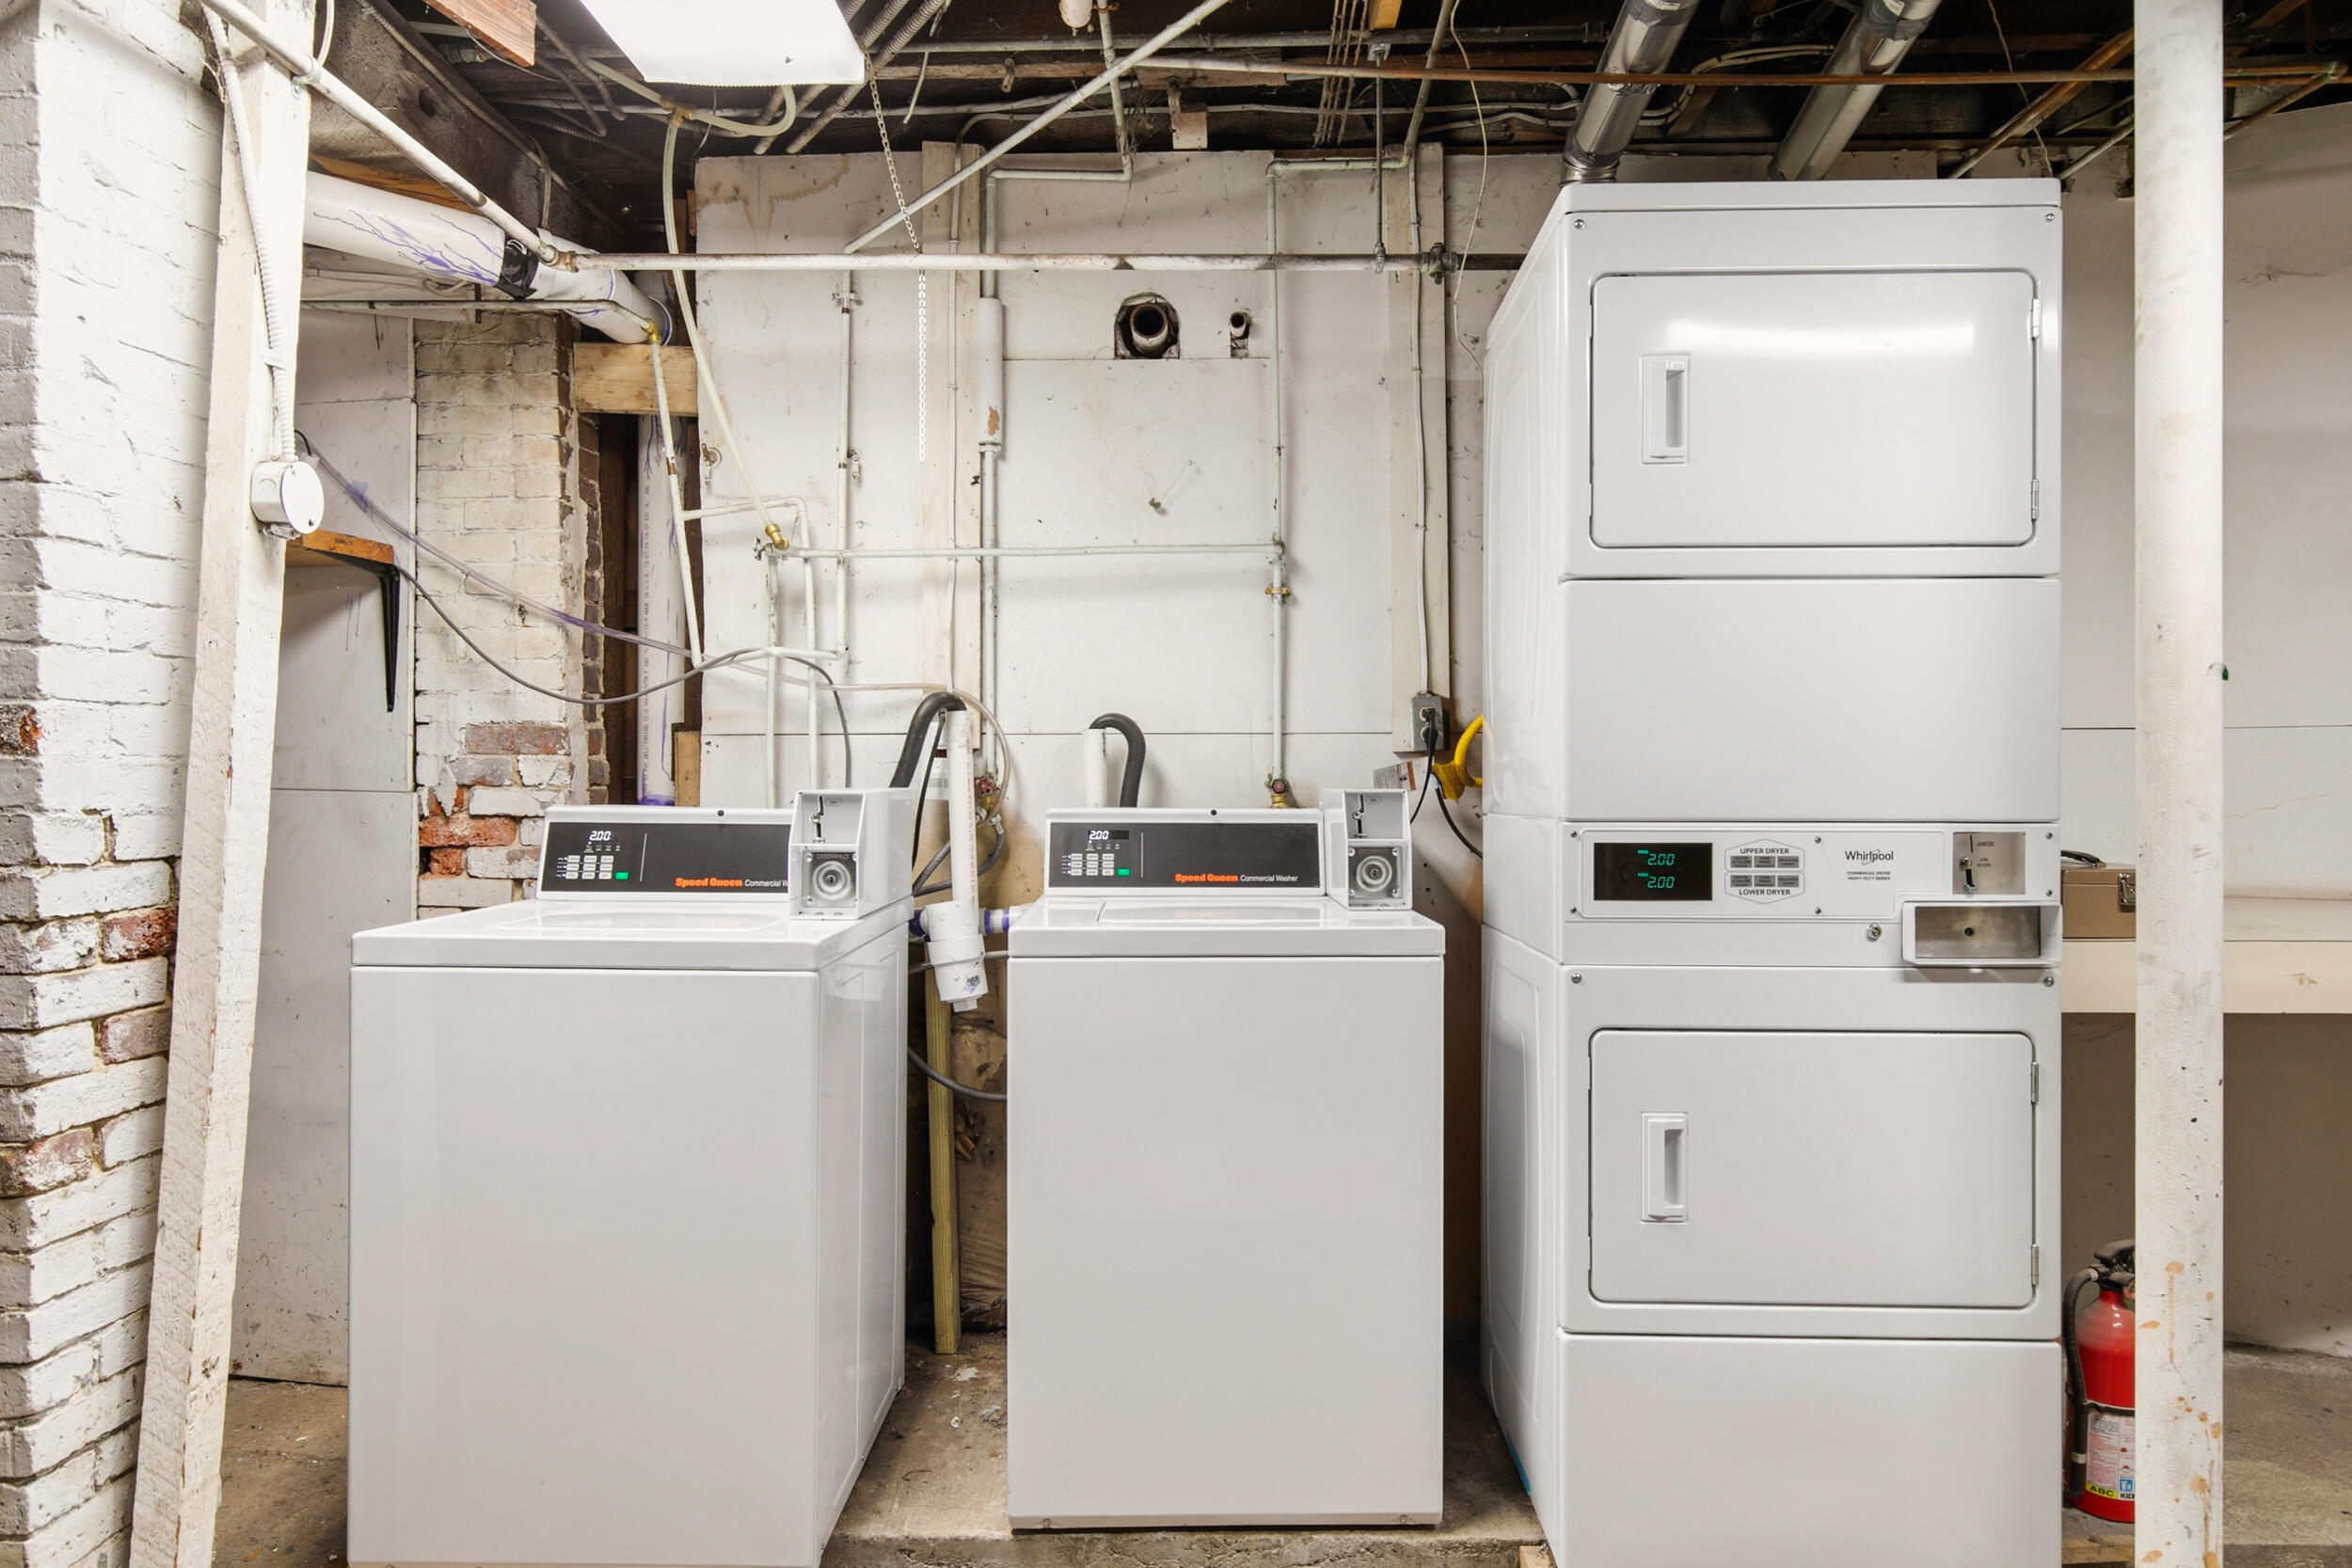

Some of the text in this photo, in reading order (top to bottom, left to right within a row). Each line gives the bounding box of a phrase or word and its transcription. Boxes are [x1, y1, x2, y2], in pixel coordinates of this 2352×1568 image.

[1648, 853, 1676, 865] 2.00
[1845, 849, 1894, 863] Whirlpool
[675, 878, 708, 888] Speed
[709, 878, 743, 887] Queen
[1175, 874, 1206, 883] Speed
[1207, 874, 1238, 882] Queen
[1648, 876, 1675, 889] 2.00
[2090, 1485, 2115, 1497] ABC
